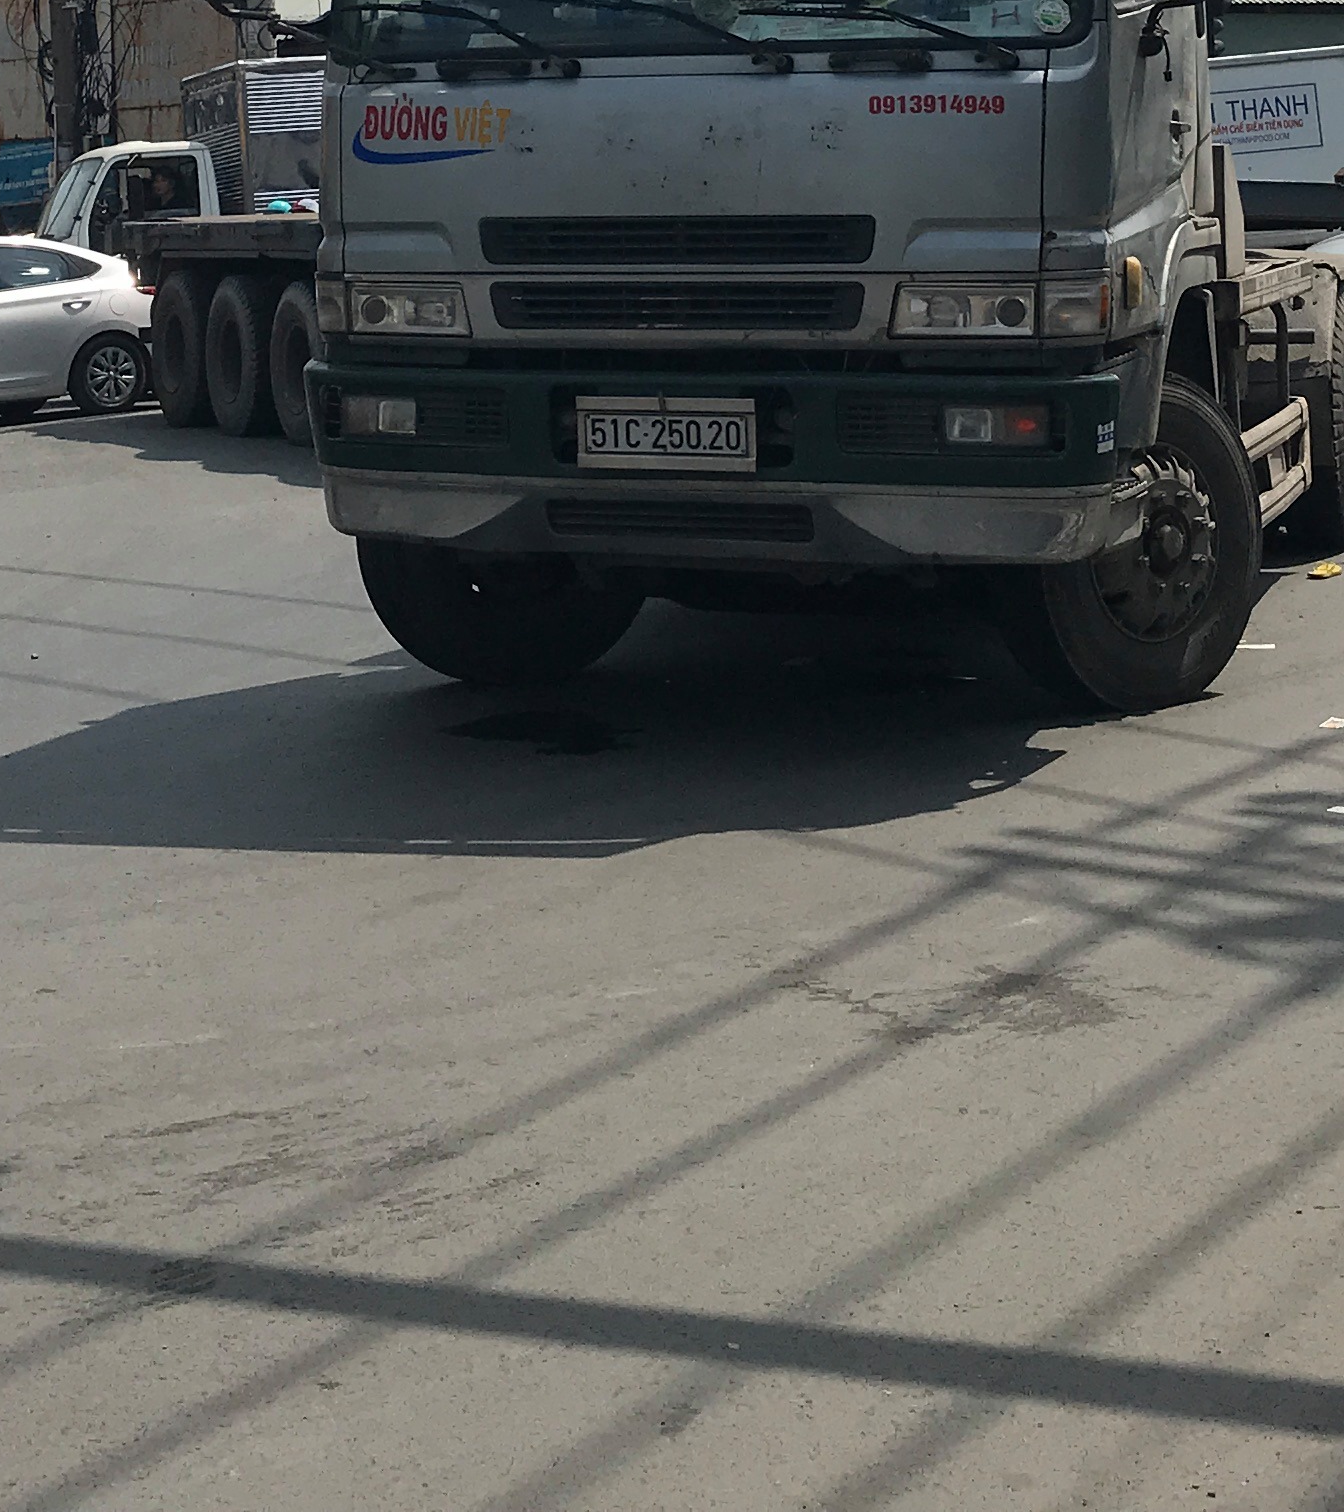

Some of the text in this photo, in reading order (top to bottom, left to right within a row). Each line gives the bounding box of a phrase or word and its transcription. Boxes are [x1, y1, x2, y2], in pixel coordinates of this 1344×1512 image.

[868, 94, 1005, 114] 0913914949
[1225, 93, 1309, 122] THANH
[454, 99, 511, 148] VIỆT
